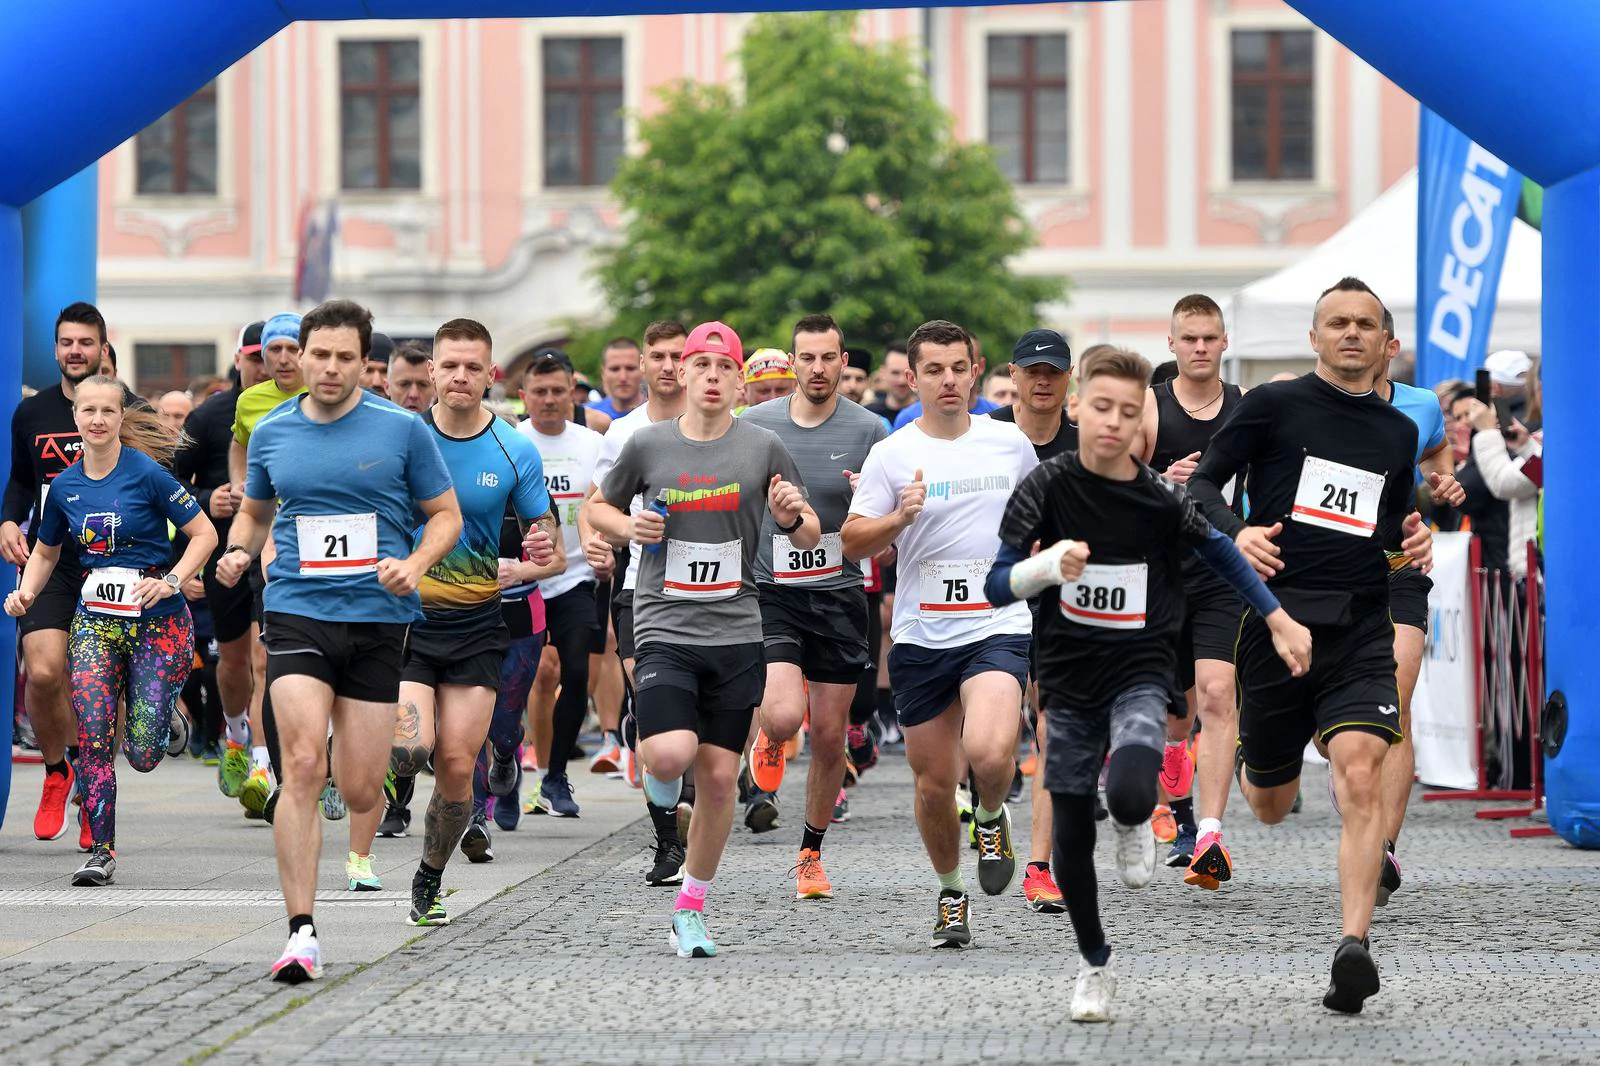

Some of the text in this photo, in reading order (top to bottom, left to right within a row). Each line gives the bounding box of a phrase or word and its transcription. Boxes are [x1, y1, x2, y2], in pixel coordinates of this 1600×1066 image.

[544, 475, 571, 492] 245
[1320, 483, 1358, 515] 241
[324, 535, 349, 558] 21
[788, 548, 827, 571] 303
[687, 561, 721, 583] 177
[96, 583, 126, 603] 407
[942, 579, 969, 602] 75
[1075, 584, 1127, 612] 380
